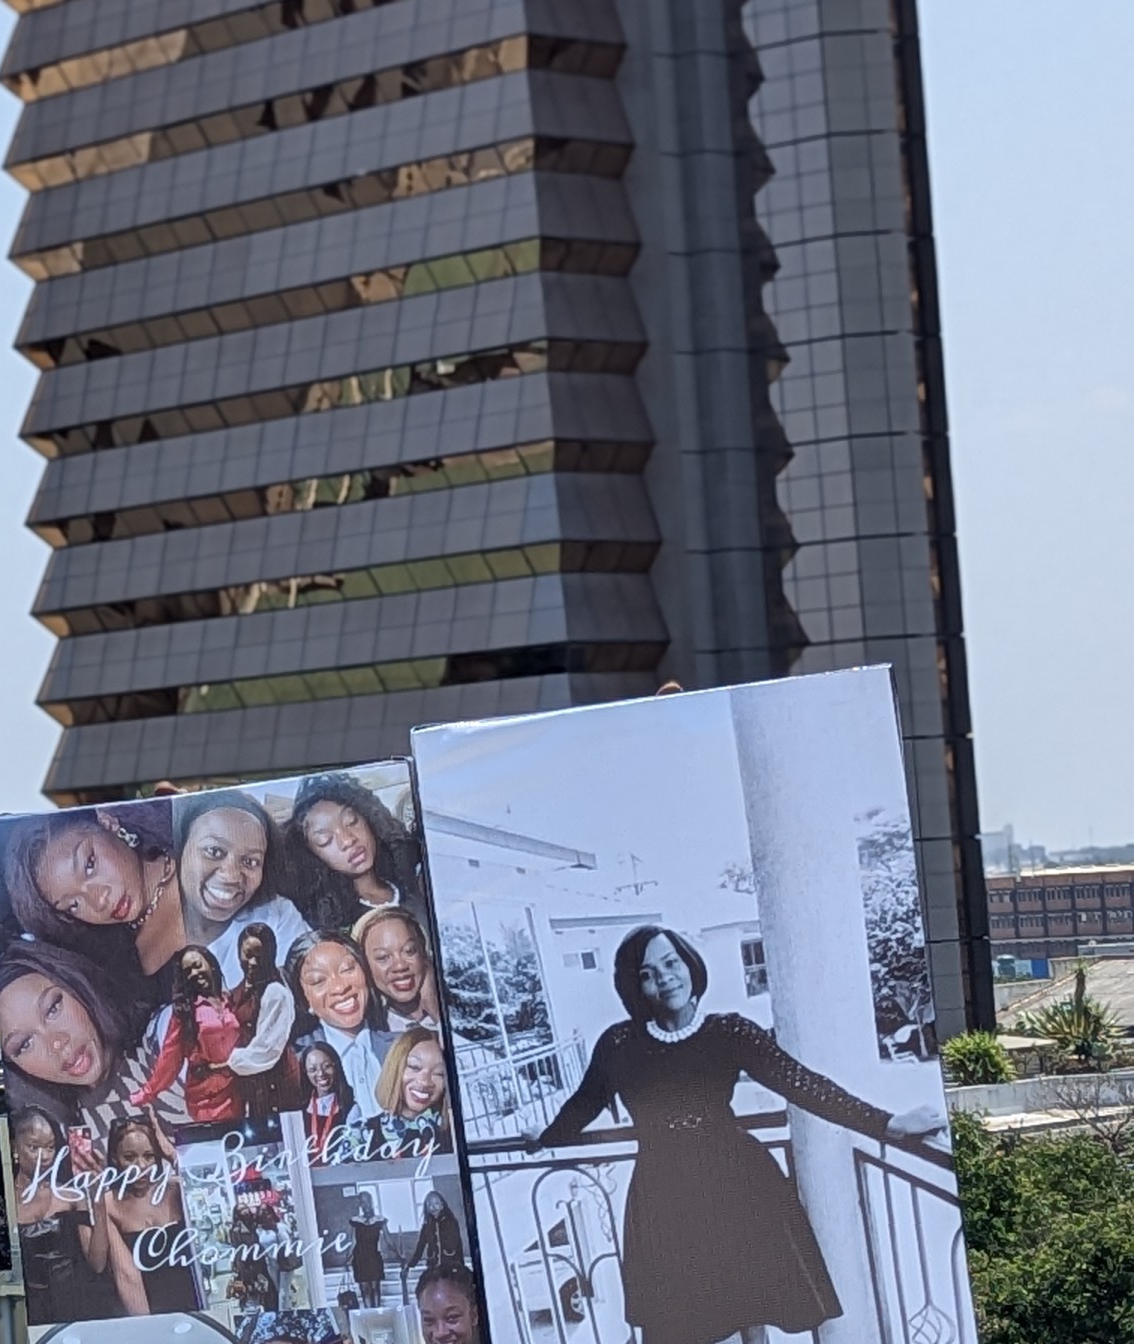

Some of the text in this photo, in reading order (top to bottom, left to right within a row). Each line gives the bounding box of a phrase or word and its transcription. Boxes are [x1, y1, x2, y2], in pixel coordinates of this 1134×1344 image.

[21, 1123, 441, 1207] Happy Birthday
[132, 1220, 354, 1272] Chommie
